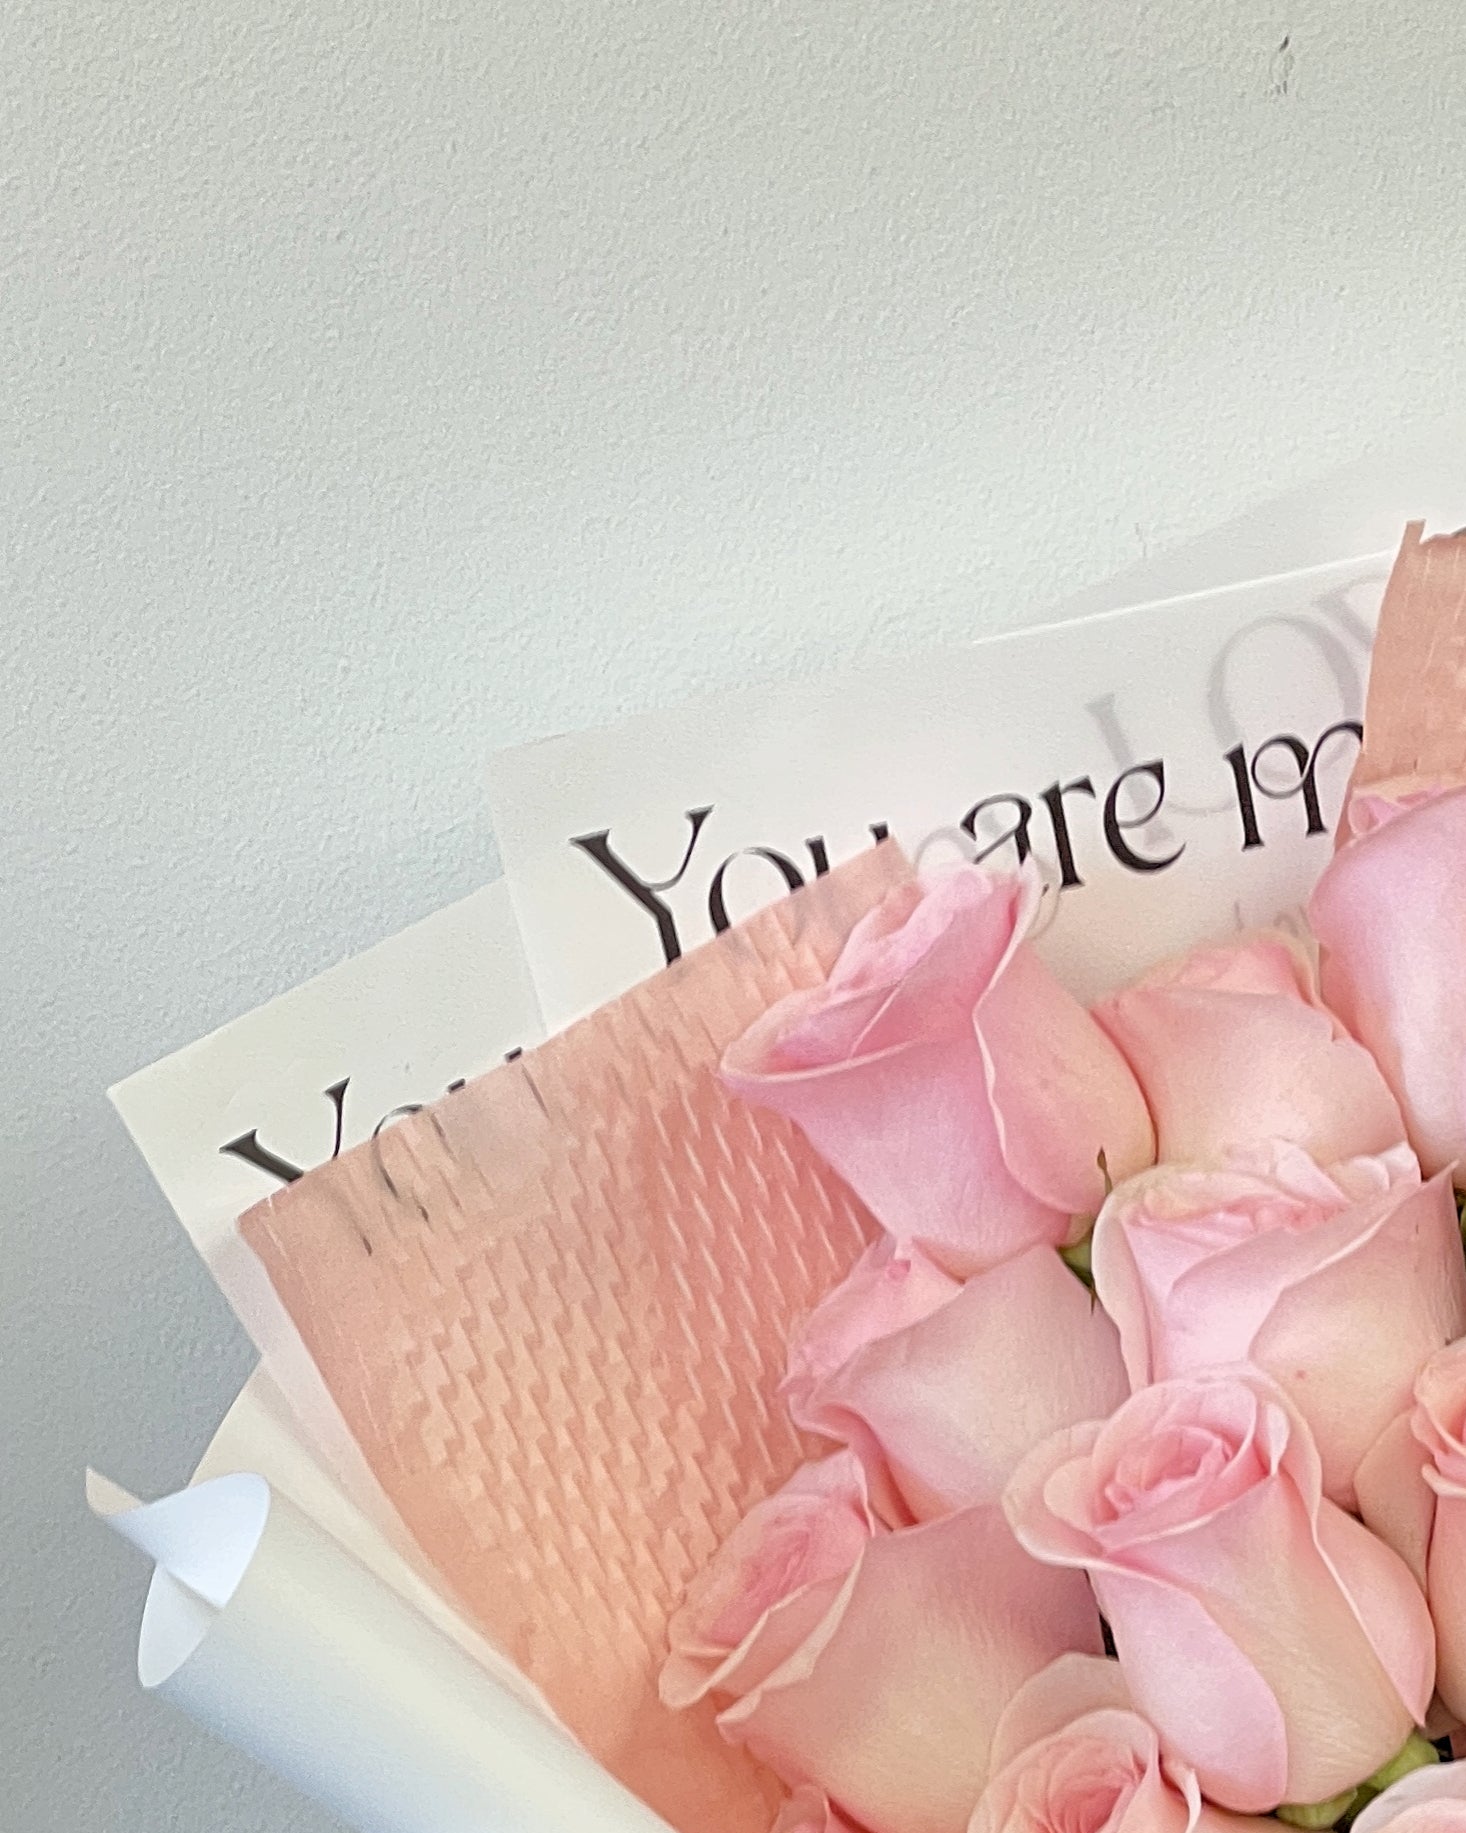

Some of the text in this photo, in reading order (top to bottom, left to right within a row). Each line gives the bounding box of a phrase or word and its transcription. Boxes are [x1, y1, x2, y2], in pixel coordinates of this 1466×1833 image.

[569, 803, 889, 966] Yo
[961, 758, 1187, 889] are
[1224, 720, 1365, 852] m
